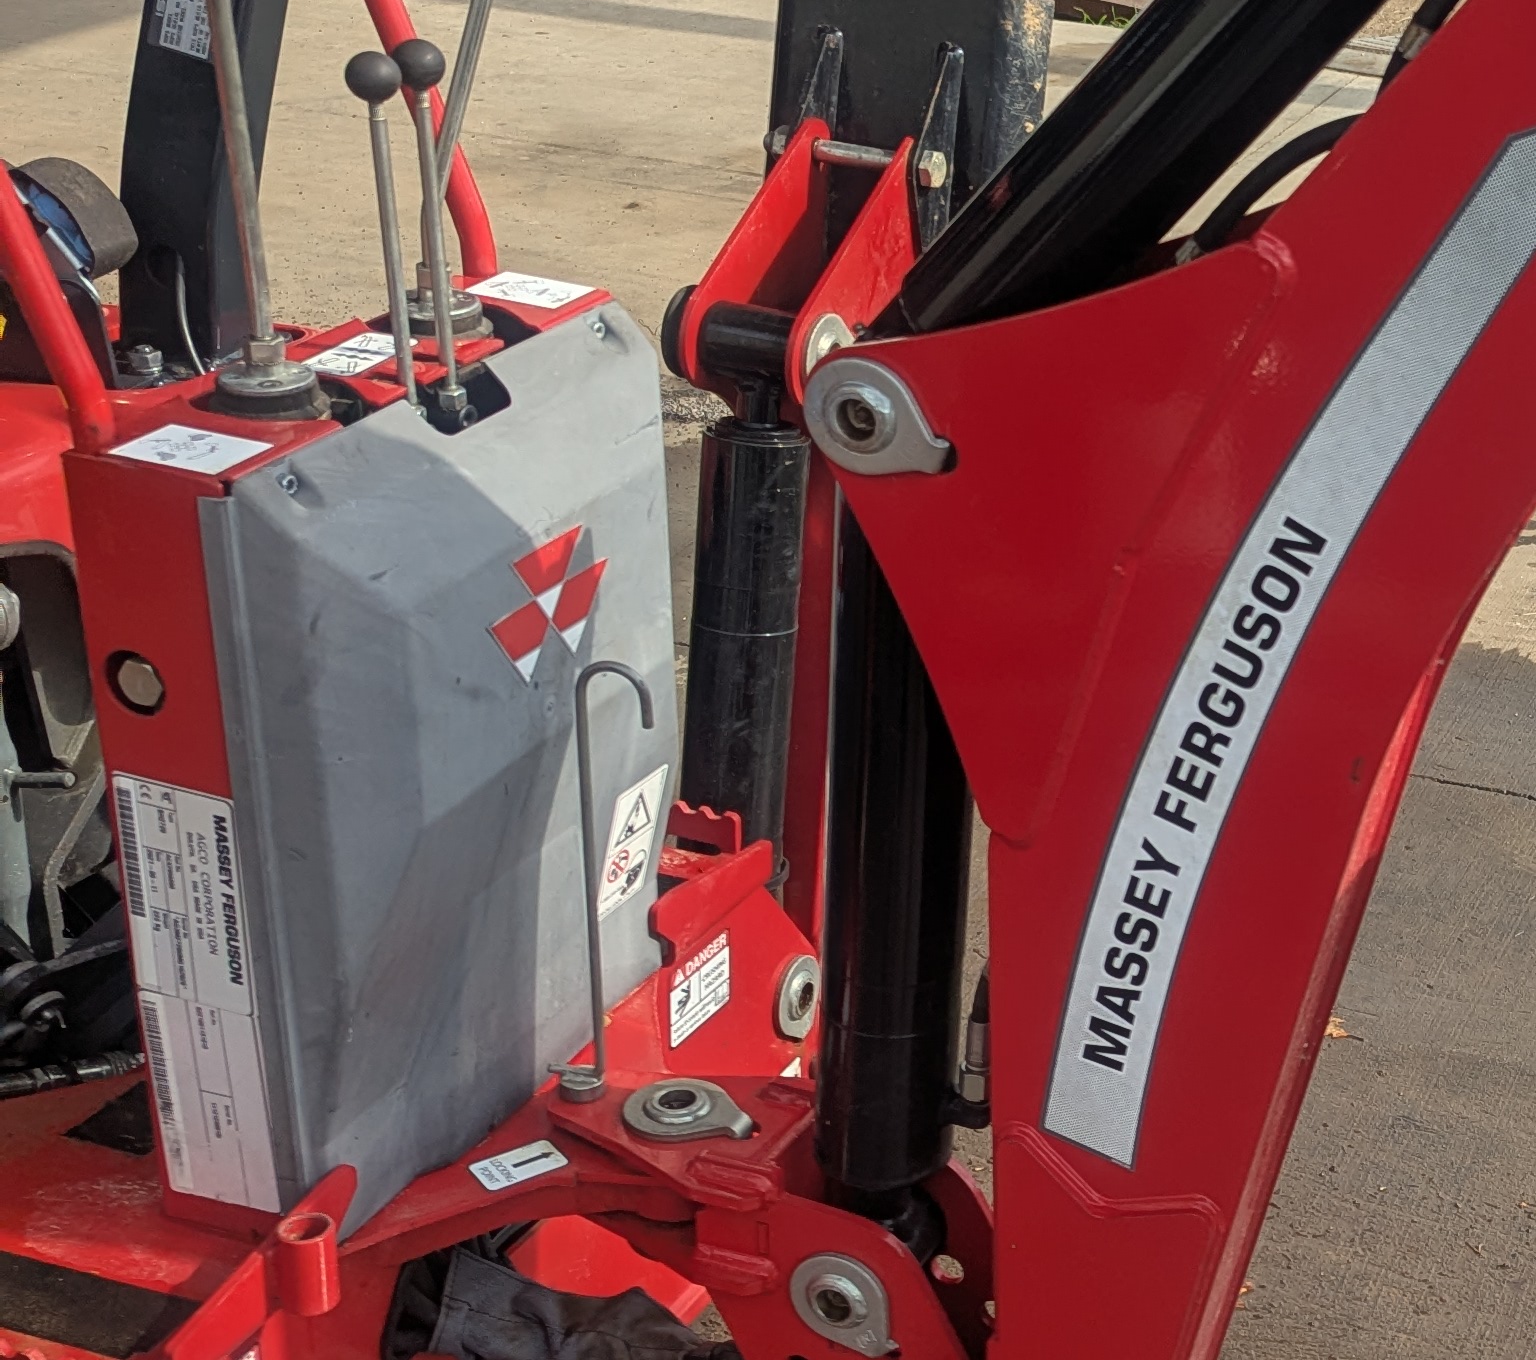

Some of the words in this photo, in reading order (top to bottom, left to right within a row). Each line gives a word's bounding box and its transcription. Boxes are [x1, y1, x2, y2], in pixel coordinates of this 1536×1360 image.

[1082, 836, 1182, 1073] MASSEY
[1153, 515, 1328, 833] FERGUSON
[196, 832, 209, 865] AGCO
[213, 814, 235, 890] MASSEY
[201, 871, 219, 956] CORPORATION
[221, 892, 244, 986] FERGUSON
[685, 933, 727, 977] DANGER
[488, 1158, 518, 1183] LOCKING
